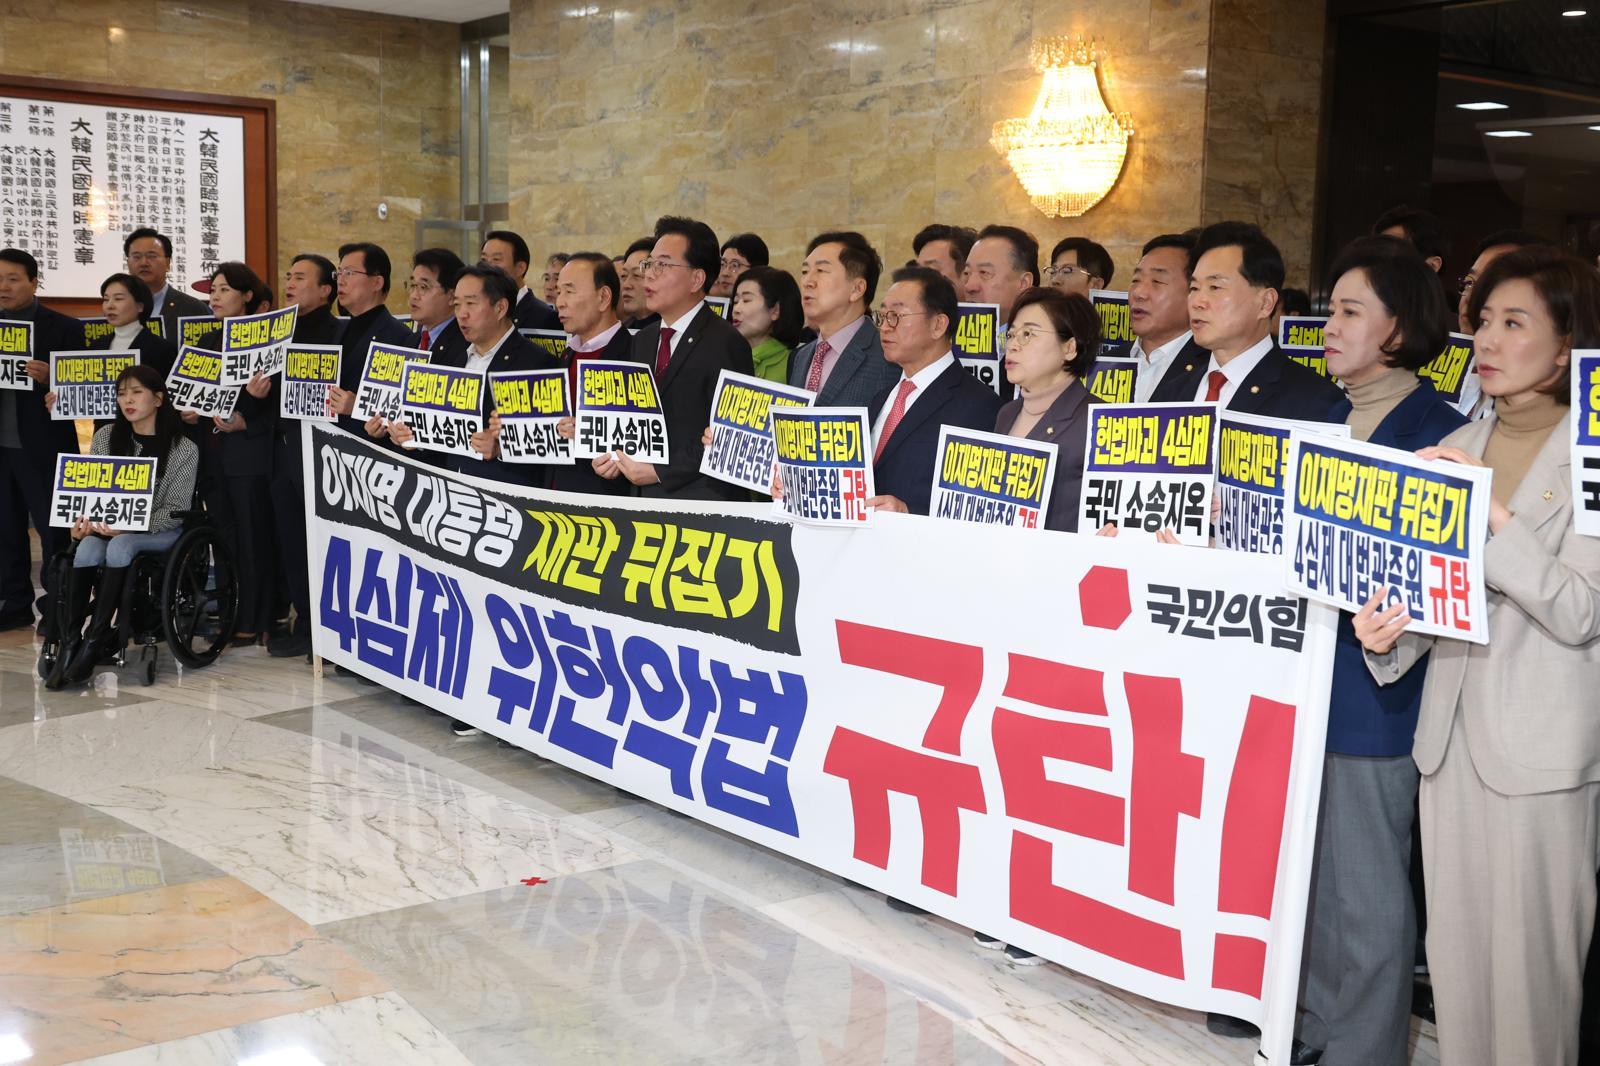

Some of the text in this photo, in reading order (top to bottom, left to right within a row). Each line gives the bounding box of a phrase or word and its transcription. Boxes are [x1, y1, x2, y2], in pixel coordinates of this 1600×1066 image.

[0, 326, 27, 353] 심제
[229, 311, 294, 349] 헌법파괴 4심제
[955, 313, 993, 354] 4심제
[57, 358, 104, 383] 이재명재판
[178, 352, 222, 380] 헌법파괴
[226, 353, 250, 381] 국민
[287, 352, 339, 381] 이재명재판 뒤집기
[368, 350, 405, 383] 헌법파괴
[56, 386, 77, 416] 4심제
[167, 379, 237, 415] 국민 소송지옥
[358, 386, 382, 416] 국민
[406, 370, 480, 411] 헌법파괴 4심제
[532, 377, 563, 414] 4심제
[583, 368, 657, 408] 헌법파괴 4심제
[717, 384, 773, 431] 이재명재판
[501, 423, 522, 457] 국민
[580, 416, 664, 458] 국민 소송지옥
[708, 426, 774, 487] 4심제 대법관증원
[775, 418, 862, 463] 이재명재판 뒤집기
[1094, 414, 1211, 467] 헌법파괴 4심제
[1220, 427, 1278, 488] 이재명재판
[63, 460, 150, 490] 헌법파괴 4심제
[943, 441, 1047, 503] 이재명재판 뒤집기
[57, 495, 147, 526] 국민 소송지옥
[793, 465, 842, 520] 대법관증원
[843, 469, 867, 521] 규탄
[1085, 479, 1123, 530] 국민
[1123, 480, 1206, 537] 소송지옥
[1298, 451, 1399, 532] 이재명재판
[1399, 475, 1468, 550] 뒤집기
[320, 443, 785, 633] 이재명 대통령 재판 뒤집기
[1240, 490, 1286, 555] 대법관증
[1294, 519, 1471, 632] 4심제 대법관증원 규탄
[1146, 583, 1309, 653] 국민의힘
[319, 535, 1297, 1001] 4심제 위헌악법 규탄!
